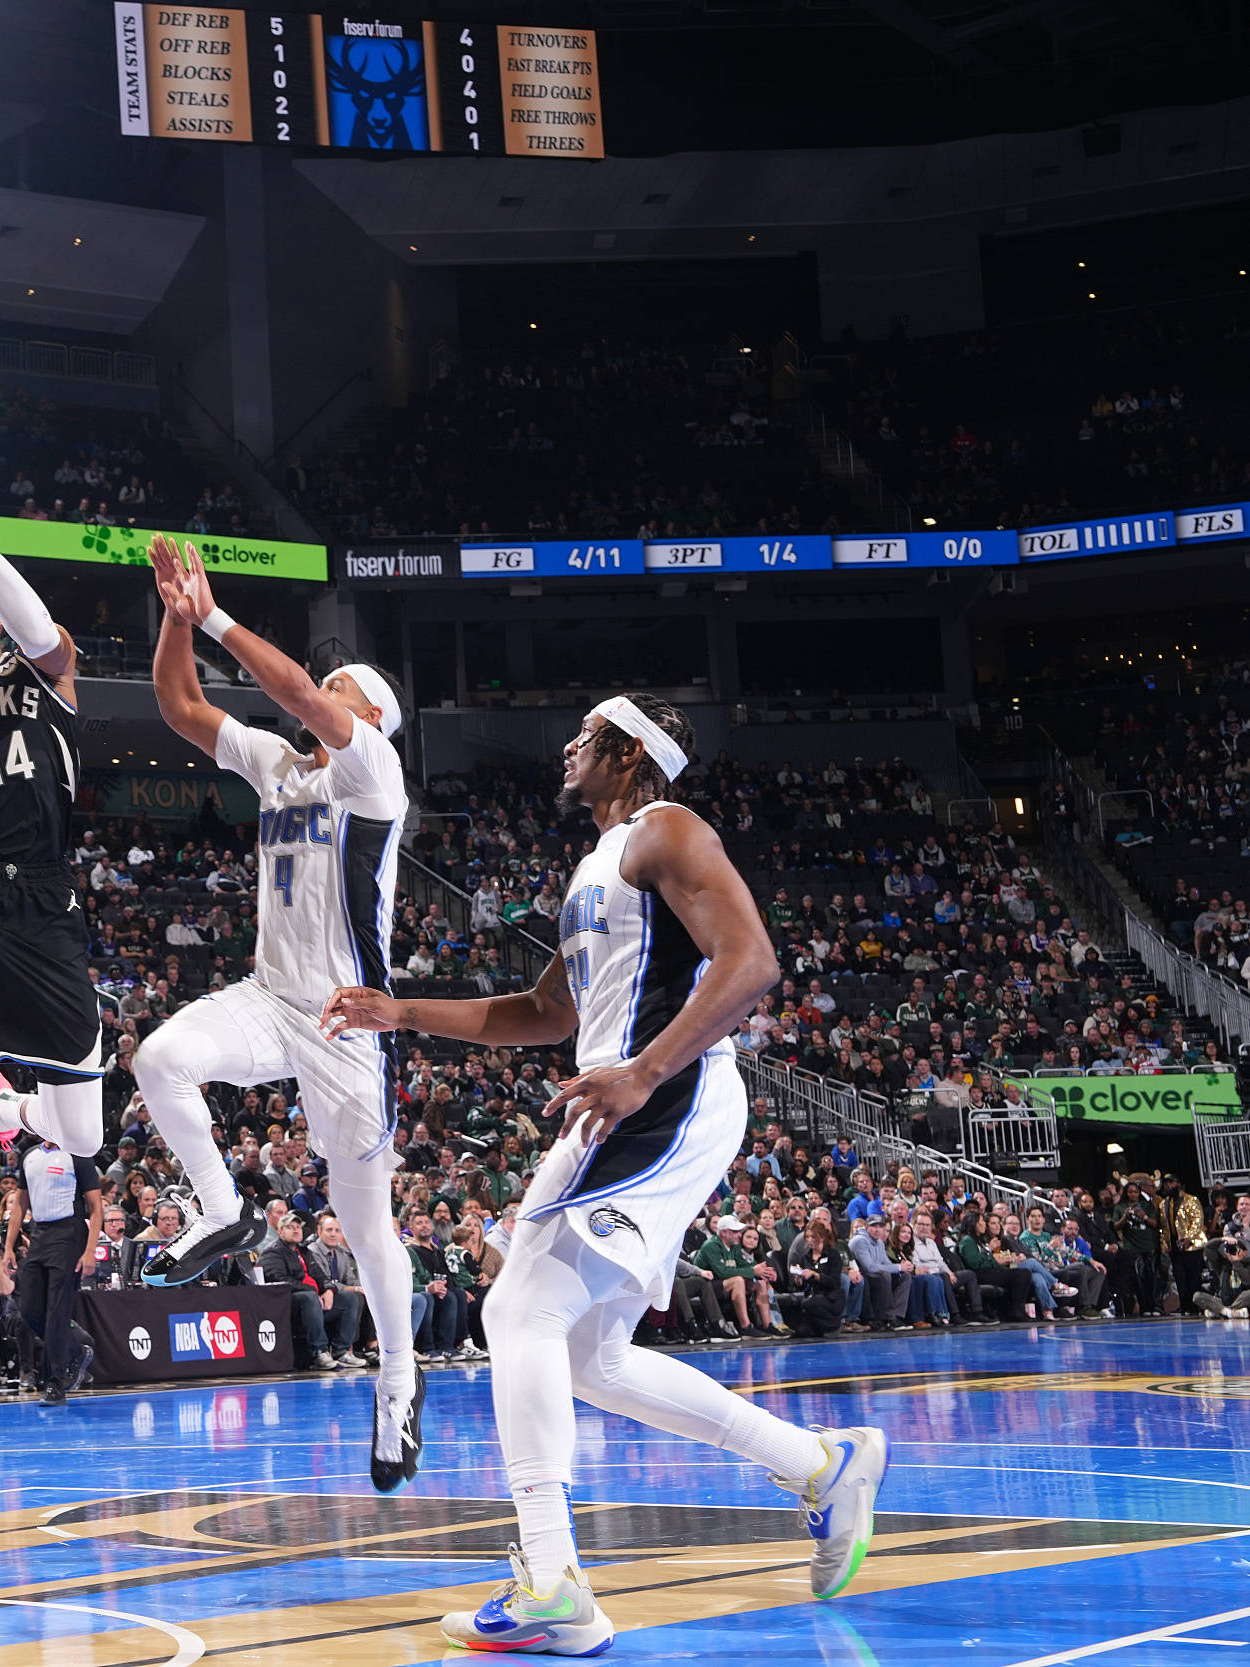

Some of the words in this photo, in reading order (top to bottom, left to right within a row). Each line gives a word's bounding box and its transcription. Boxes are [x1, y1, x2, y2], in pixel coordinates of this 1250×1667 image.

[158, 11, 192, 27] DEF
[196, 14, 230, 29] REB
[270, 17, 284, 36] 5
[123, 16, 138, 67] STATS
[160, 38, 193, 53] OFF
[197, 40, 231, 55] REB
[460, 28, 473, 47] 4
[508, 32, 588, 50] TURNOVERS
[274, 44, 285, 62] 1
[162, 64, 232, 81] BLOCKS
[461, 54, 475, 73] 0
[507, 57, 533, 73] FAST
[534, 59, 572, 75] BREAK
[572, 61, 592, 75] PTS
[273, 70, 287, 89] 0
[126, 72, 141, 122] TEAM
[463, 80, 477, 99] 4
[511, 83, 548, 99] FIELD
[550, 85, 592, 101] GOALS
[167, 91, 229, 108] STEALS
[275, 96, 289, 115] 2
[465, 106, 478, 125] 0
[511, 109, 541, 124] FREE
[544, 110, 596, 127] THROWS
[167, 117, 233, 134] ASSISTS
[277, 122, 290, 141] 2
[469, 132, 479, 151] 1
[526, 135, 584, 152] THREES
[1192, 514, 1234, 535] FLS
[866, 543, 897, 560] FT
[944, 538, 982, 560] 0/0
[1025, 533, 1071, 553] TOL
[222, 545, 276, 566] clover
[492, 551, 522, 569] FG
[568, 546, 621, 570] 4/11
[668, 547, 711, 565] 3PT
[759, 542, 797, 565] 1/4
[345, 550, 442, 577] fiserv.forum
[131, 776, 224, 810] KONA
[274, 854, 294, 907] 4
[1089, 1084, 1193, 1112] clover
[174, 1322, 200, 1351] NBA
